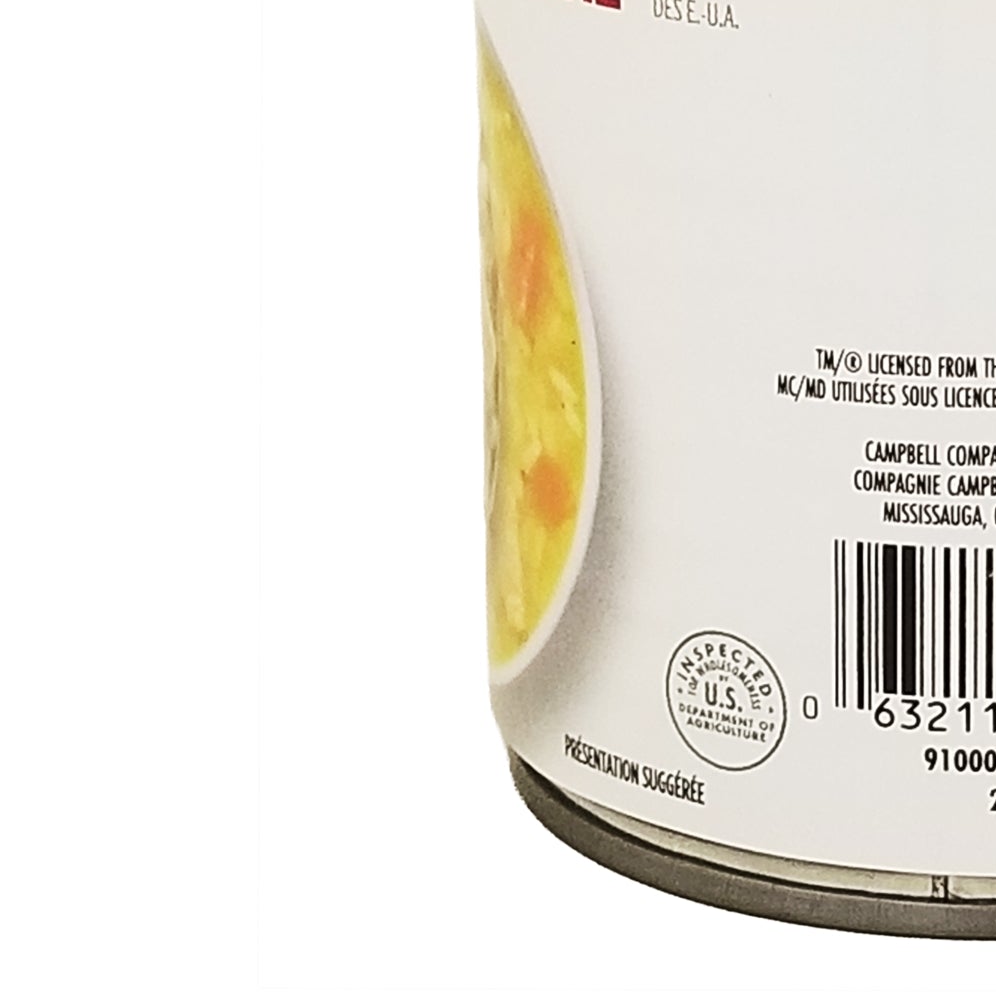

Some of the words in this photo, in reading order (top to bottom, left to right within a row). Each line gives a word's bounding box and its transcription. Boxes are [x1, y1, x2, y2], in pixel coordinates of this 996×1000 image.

[868, 353, 932, 377] LICENSED
[938, 356, 978, 378] FROM
[777, 374, 826, 402] MC/MD
[831, 377, 896, 405] UTILISÉES
[901, 384, 938, 408] SOUS
[865, 440, 941, 466] CAMPBELL
[853, 469, 941, 496] COMPAGNIE
[883, 502, 987, 530] MISSISSAUGA,
[677, 643, 771, 696] INSPECTED
[705, 681, 742, 712] U.S.
[803, 696, 818, 719] 0
[679, 703, 753, 728] DEPARTMENT
[759, 721, 774, 731] OF
[687, 717, 765, 742] AGRICULTURE
[565, 734, 639, 785] PRÉSENTATION
[642, 766, 705, 805] SUGGÉRÉE
